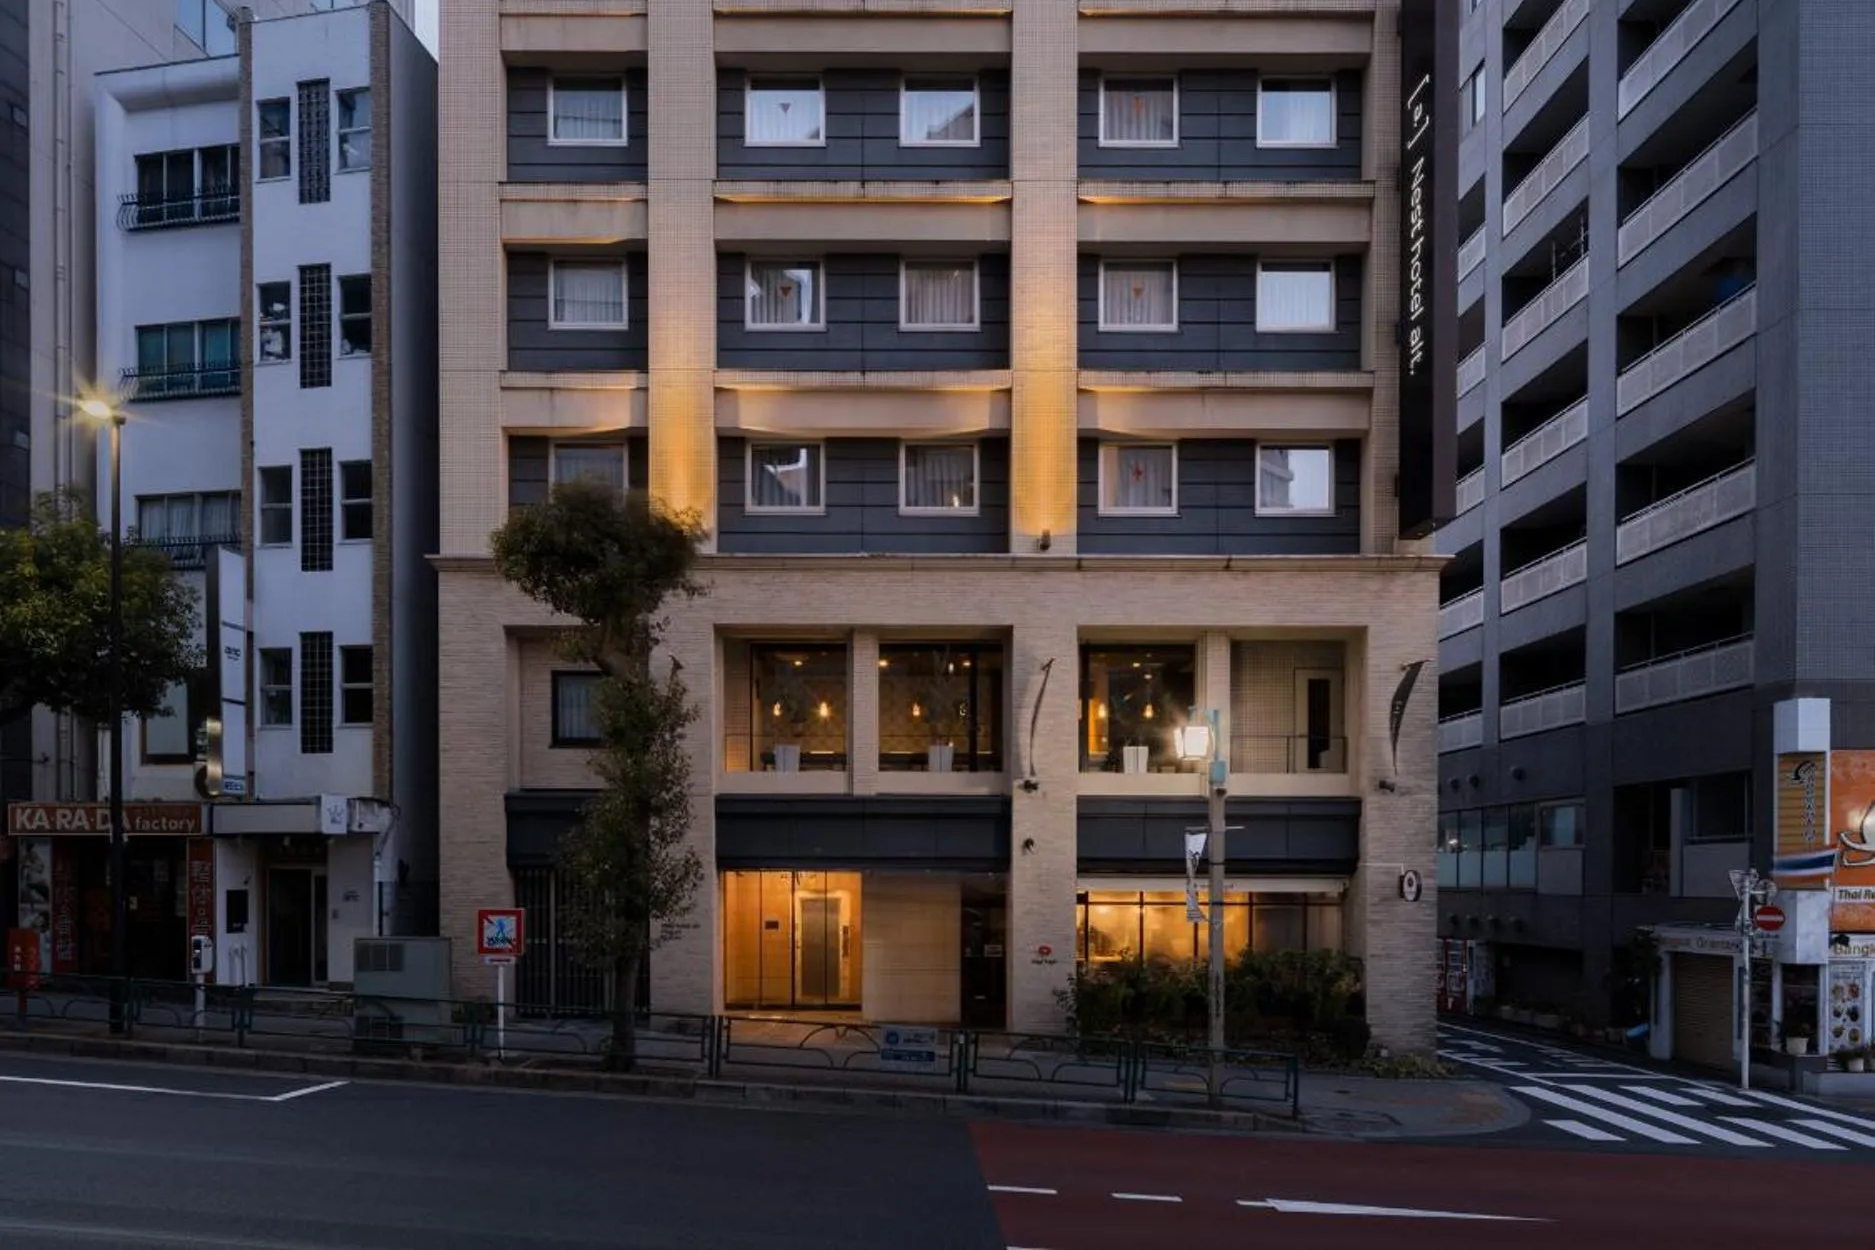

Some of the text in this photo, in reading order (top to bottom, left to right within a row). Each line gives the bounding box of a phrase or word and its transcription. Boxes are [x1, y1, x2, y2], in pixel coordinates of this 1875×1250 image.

[1410, 156, 1424, 238] Nest
[1410, 236, 1424, 321] hotel
[1410, 326, 1424, 375] alt.
[135, 818, 196, 831] factory
[1839, 890, 1861, 899] Thai
